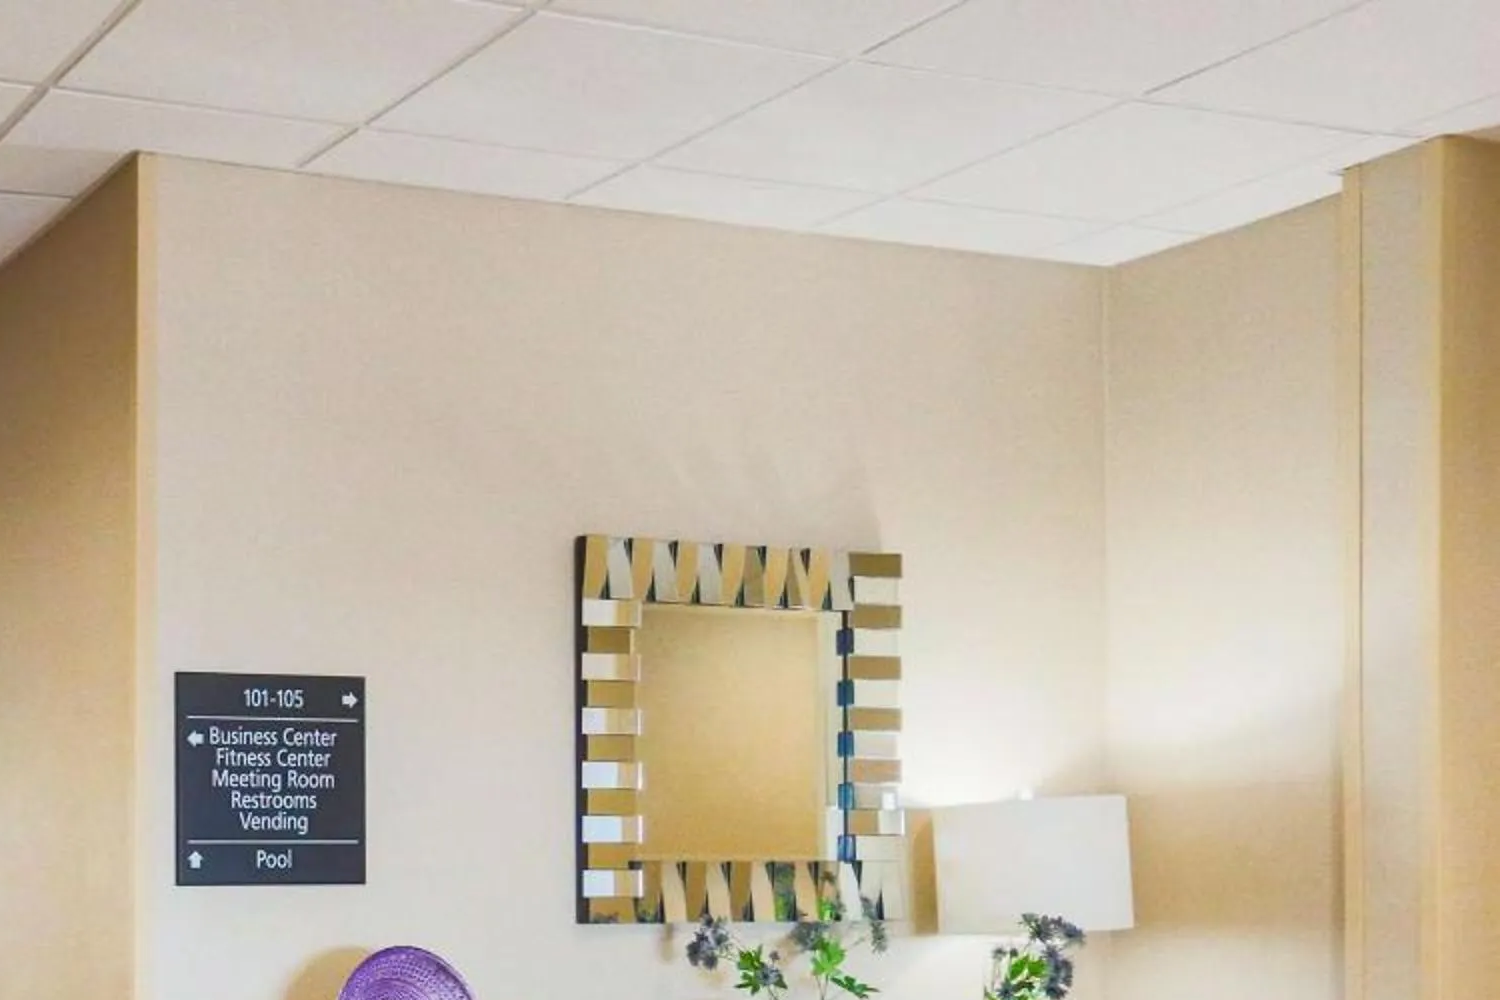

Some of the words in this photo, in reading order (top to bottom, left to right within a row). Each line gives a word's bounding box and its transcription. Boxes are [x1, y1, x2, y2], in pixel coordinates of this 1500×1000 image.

[243, 689, 304, 708] 101-105
[209, 726, 278, 745] Business
[283, 728, 337, 747] Center
[216, 748, 271, 767] Fitness
[276, 749, 331, 768] Center
[211, 769, 281, 792] Meeting
[287, 770, 335, 789] Room
[231, 791, 317, 809] Restrooms
[239, 811, 309, 835] Vending
[256, 849, 293, 869] Pool
